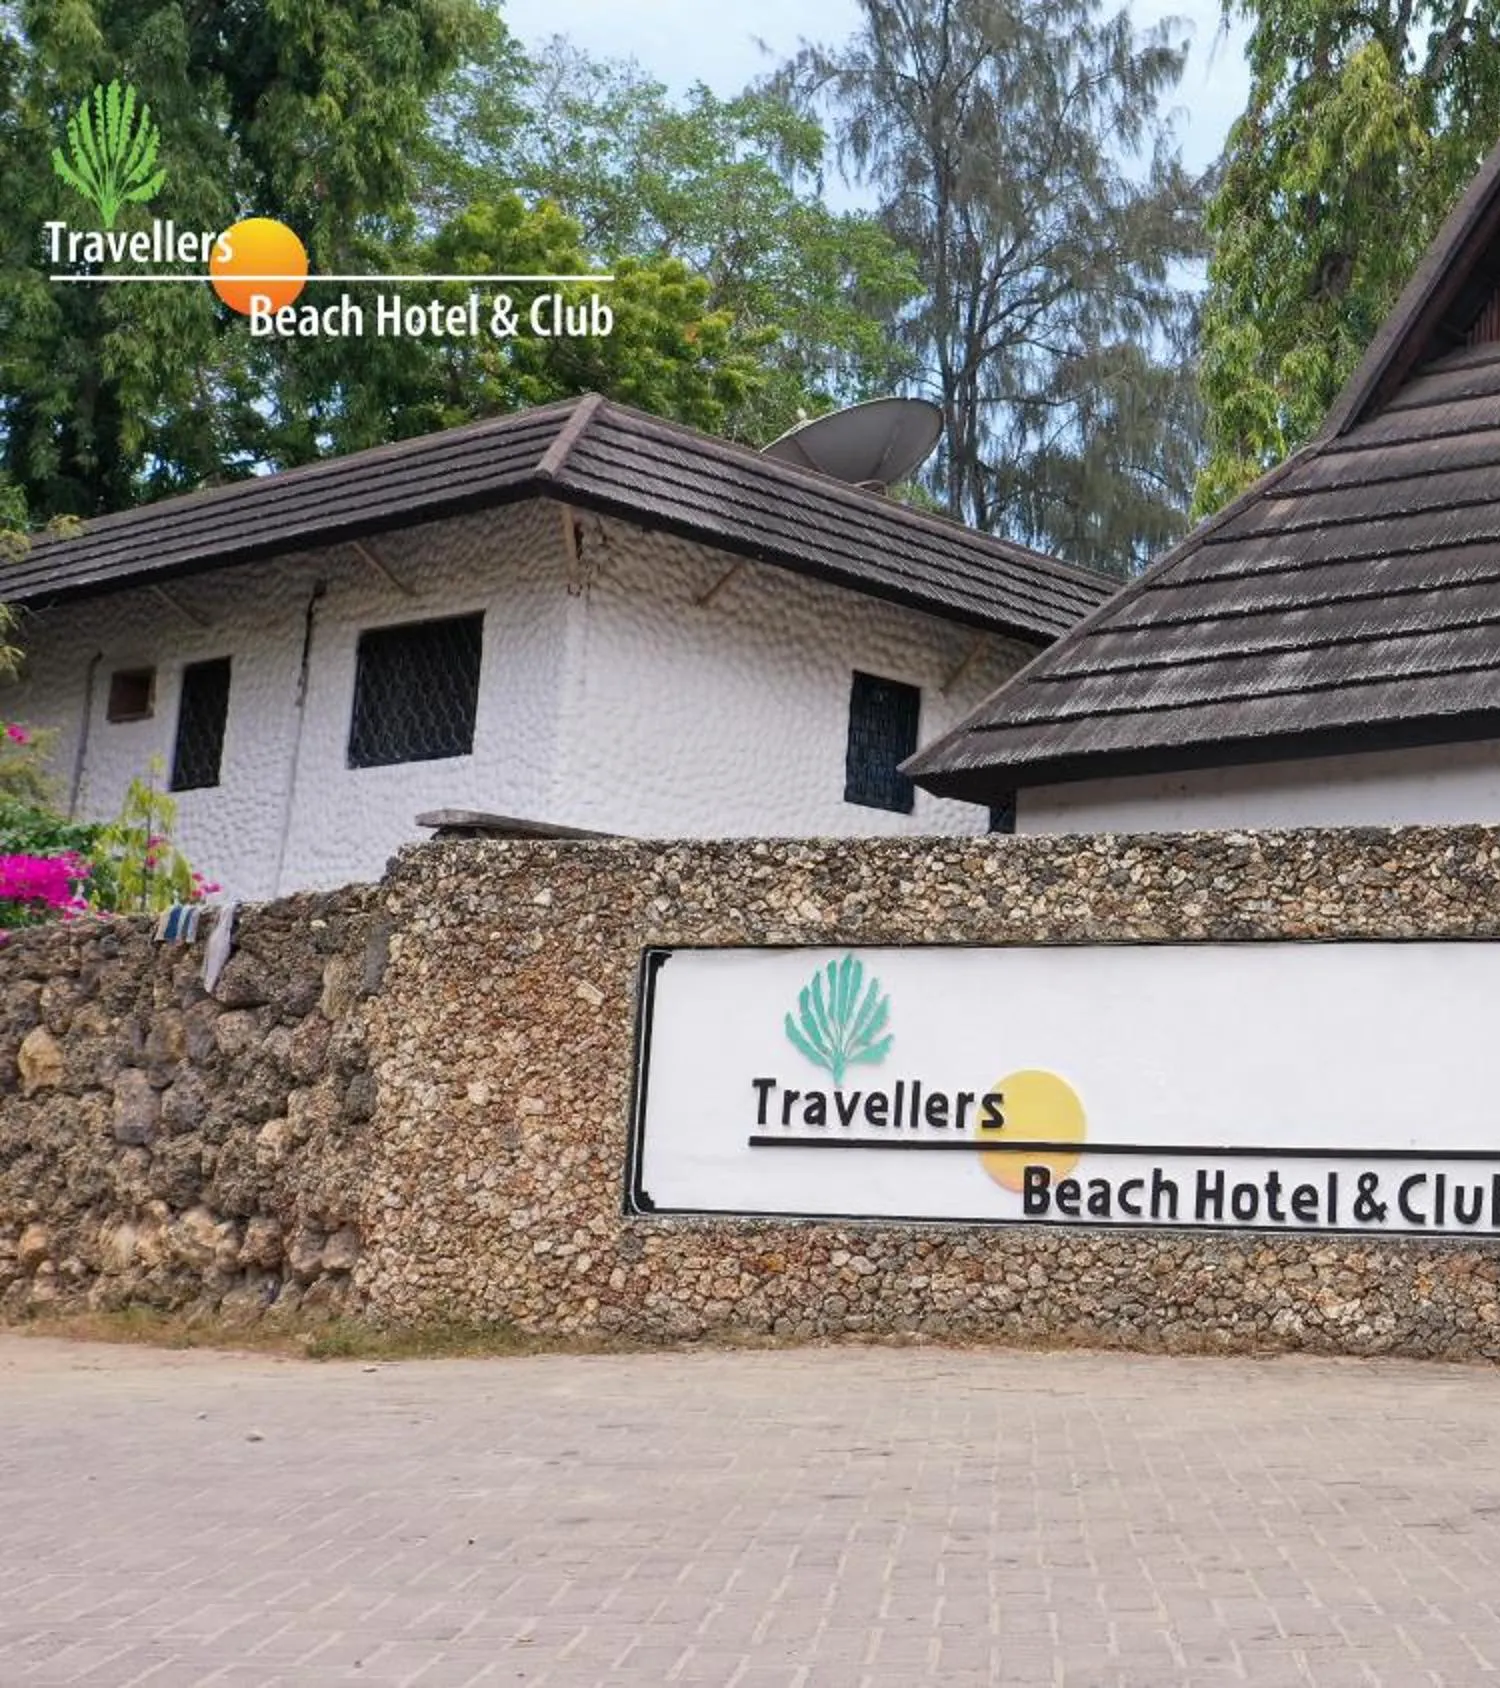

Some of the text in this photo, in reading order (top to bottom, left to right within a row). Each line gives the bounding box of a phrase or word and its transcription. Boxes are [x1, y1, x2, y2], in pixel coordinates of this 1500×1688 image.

[752, 1077, 1005, 1130] Travellers
[1022, 1165, 1180, 1220] Beach
[1195, 1169, 1339, 1225] Hotel
[1353, 1171, 1388, 1223] &
